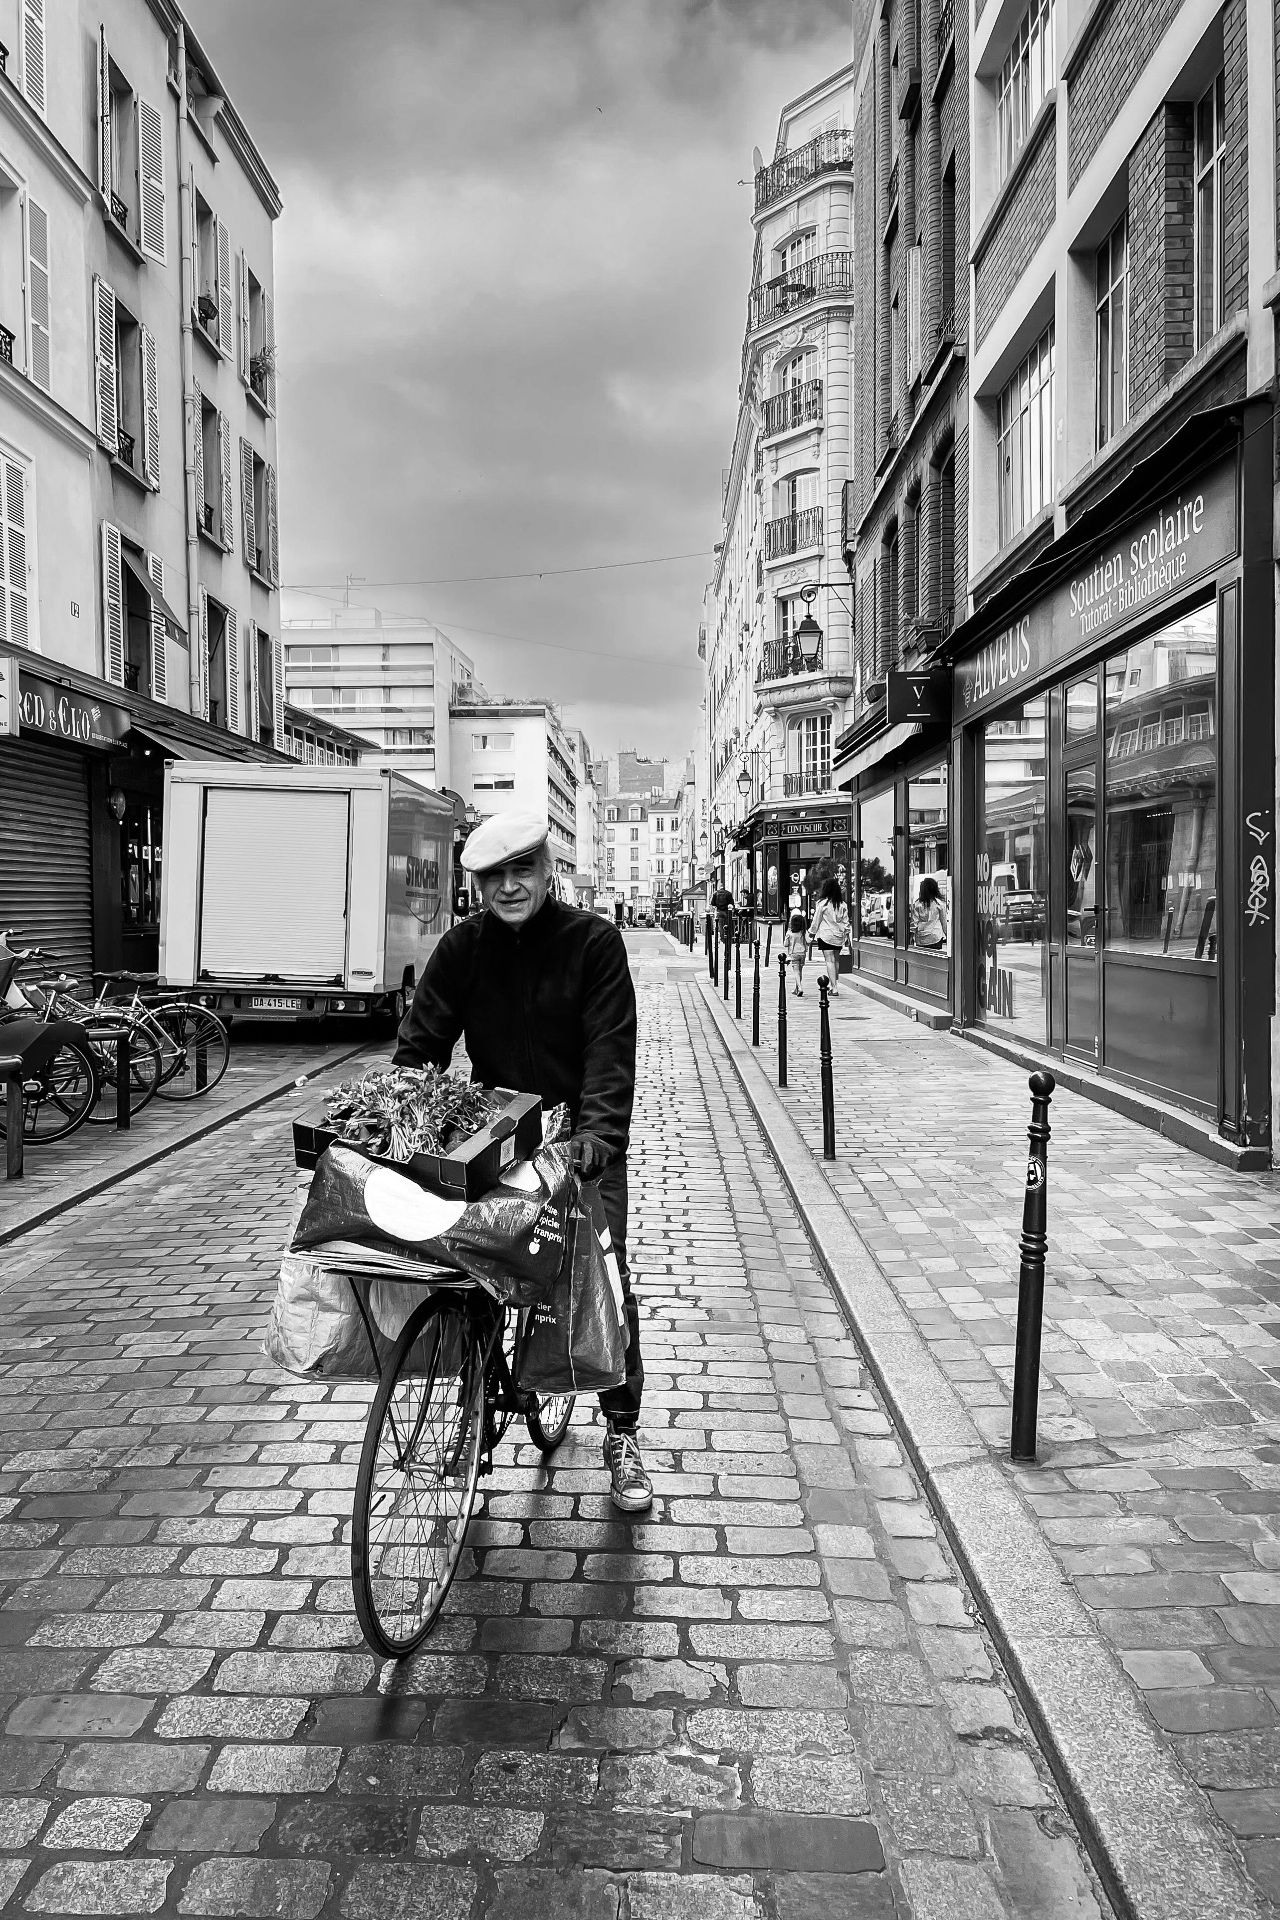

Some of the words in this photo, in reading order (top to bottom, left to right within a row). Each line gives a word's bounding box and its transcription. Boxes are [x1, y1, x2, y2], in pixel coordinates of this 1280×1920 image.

[1070, 555, 1124, 617] Soutien
[1130, 495, 1204, 576] scolaire
[973, 614, 1031, 703] ALVEUS
[976, 853, 990, 882] NO
[977, 962, 1013, 1019] GAIN
